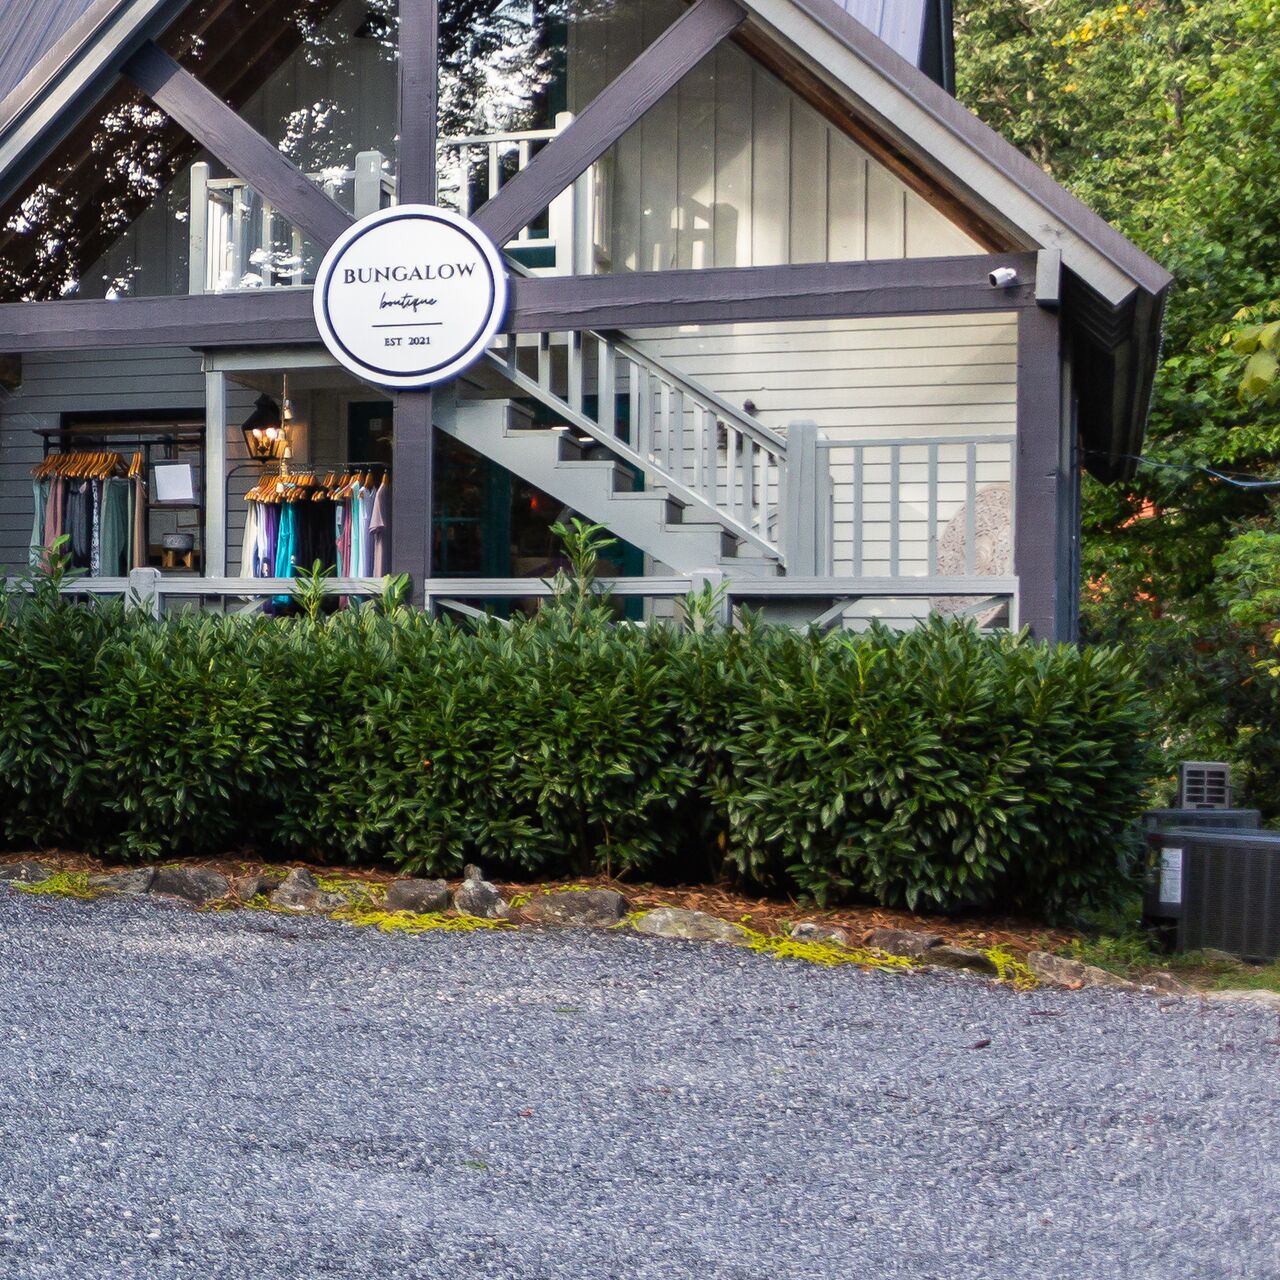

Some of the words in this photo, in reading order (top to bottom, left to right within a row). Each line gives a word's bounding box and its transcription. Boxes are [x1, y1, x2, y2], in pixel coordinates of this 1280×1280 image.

[343, 262, 476, 284] BUNGALOW
[379, 292, 437, 313] boutique
[384, 337, 403, 347] EST
[407, 336, 431, 346] 2021
